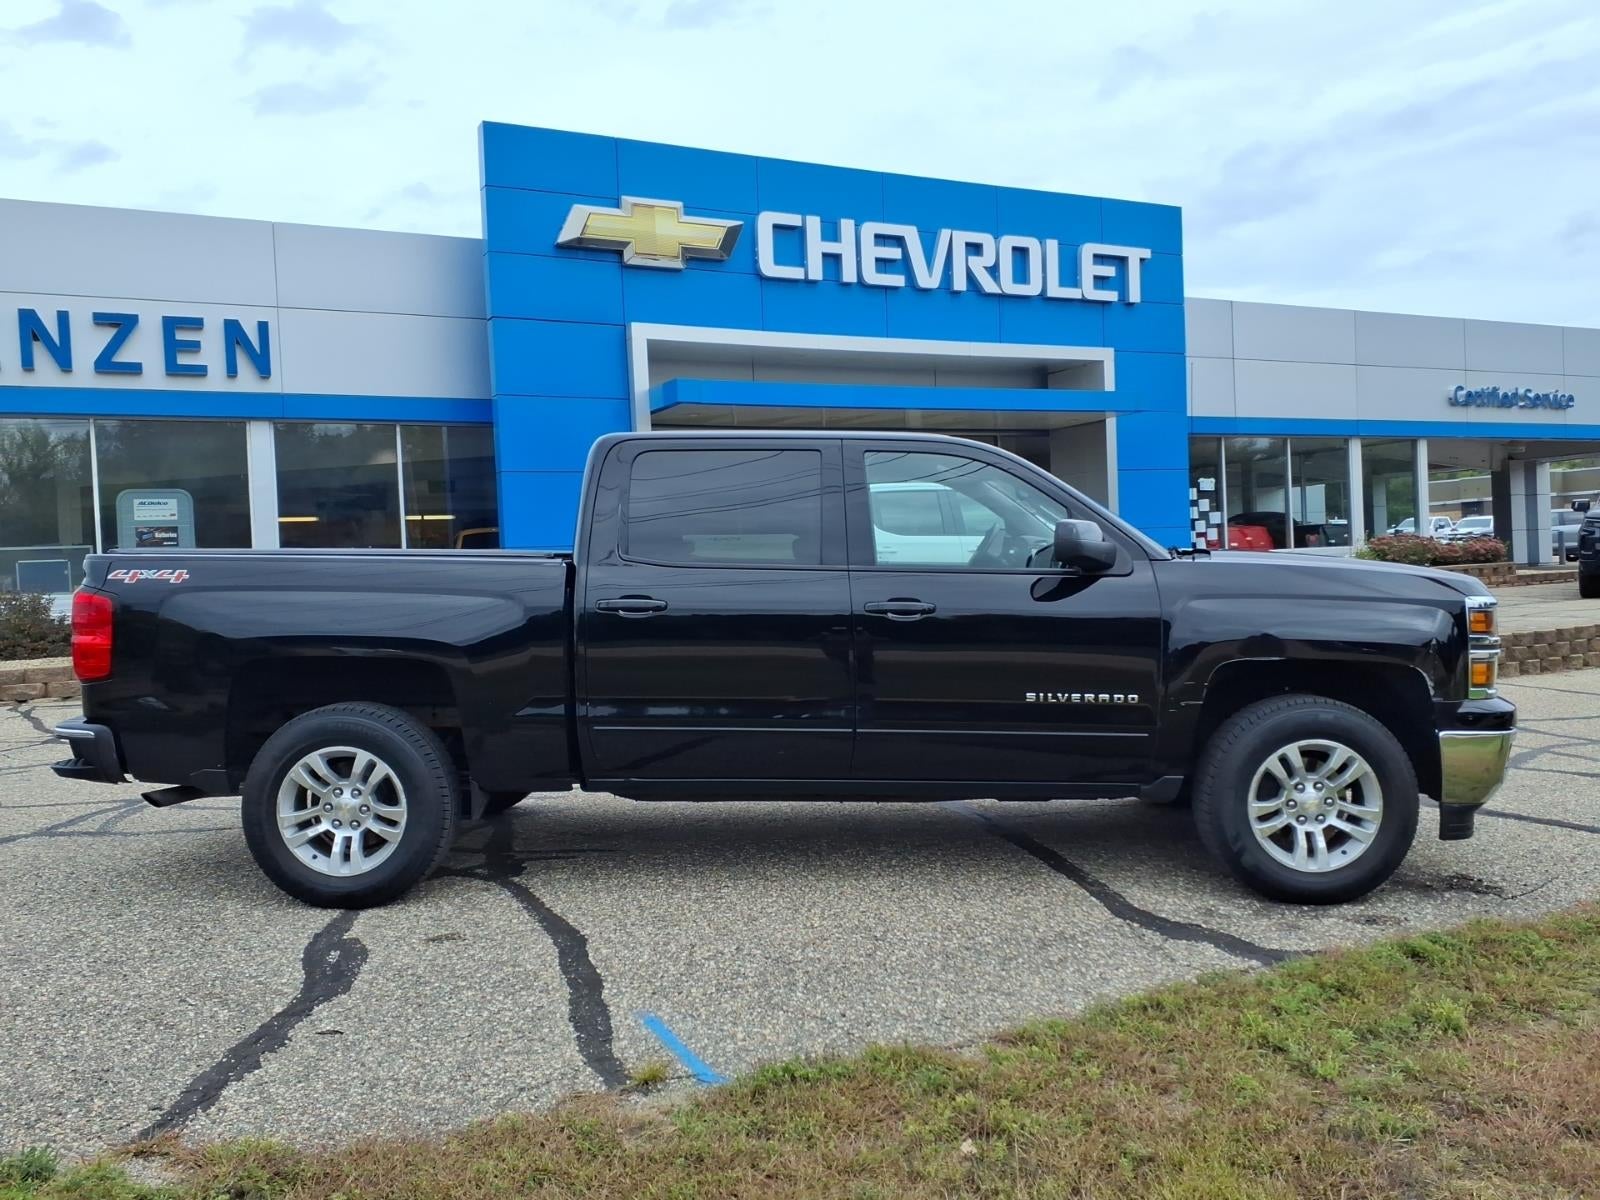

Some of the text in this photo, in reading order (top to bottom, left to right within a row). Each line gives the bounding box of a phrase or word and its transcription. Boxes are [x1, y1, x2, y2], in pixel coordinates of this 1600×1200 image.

[757, 211, 1152, 304] CHEVROLET
[18, 308, 271, 378] NZEN
[1451, 385, 1574, 409] Certified Service
[1025, 692, 1139, 703] SILVERADO
